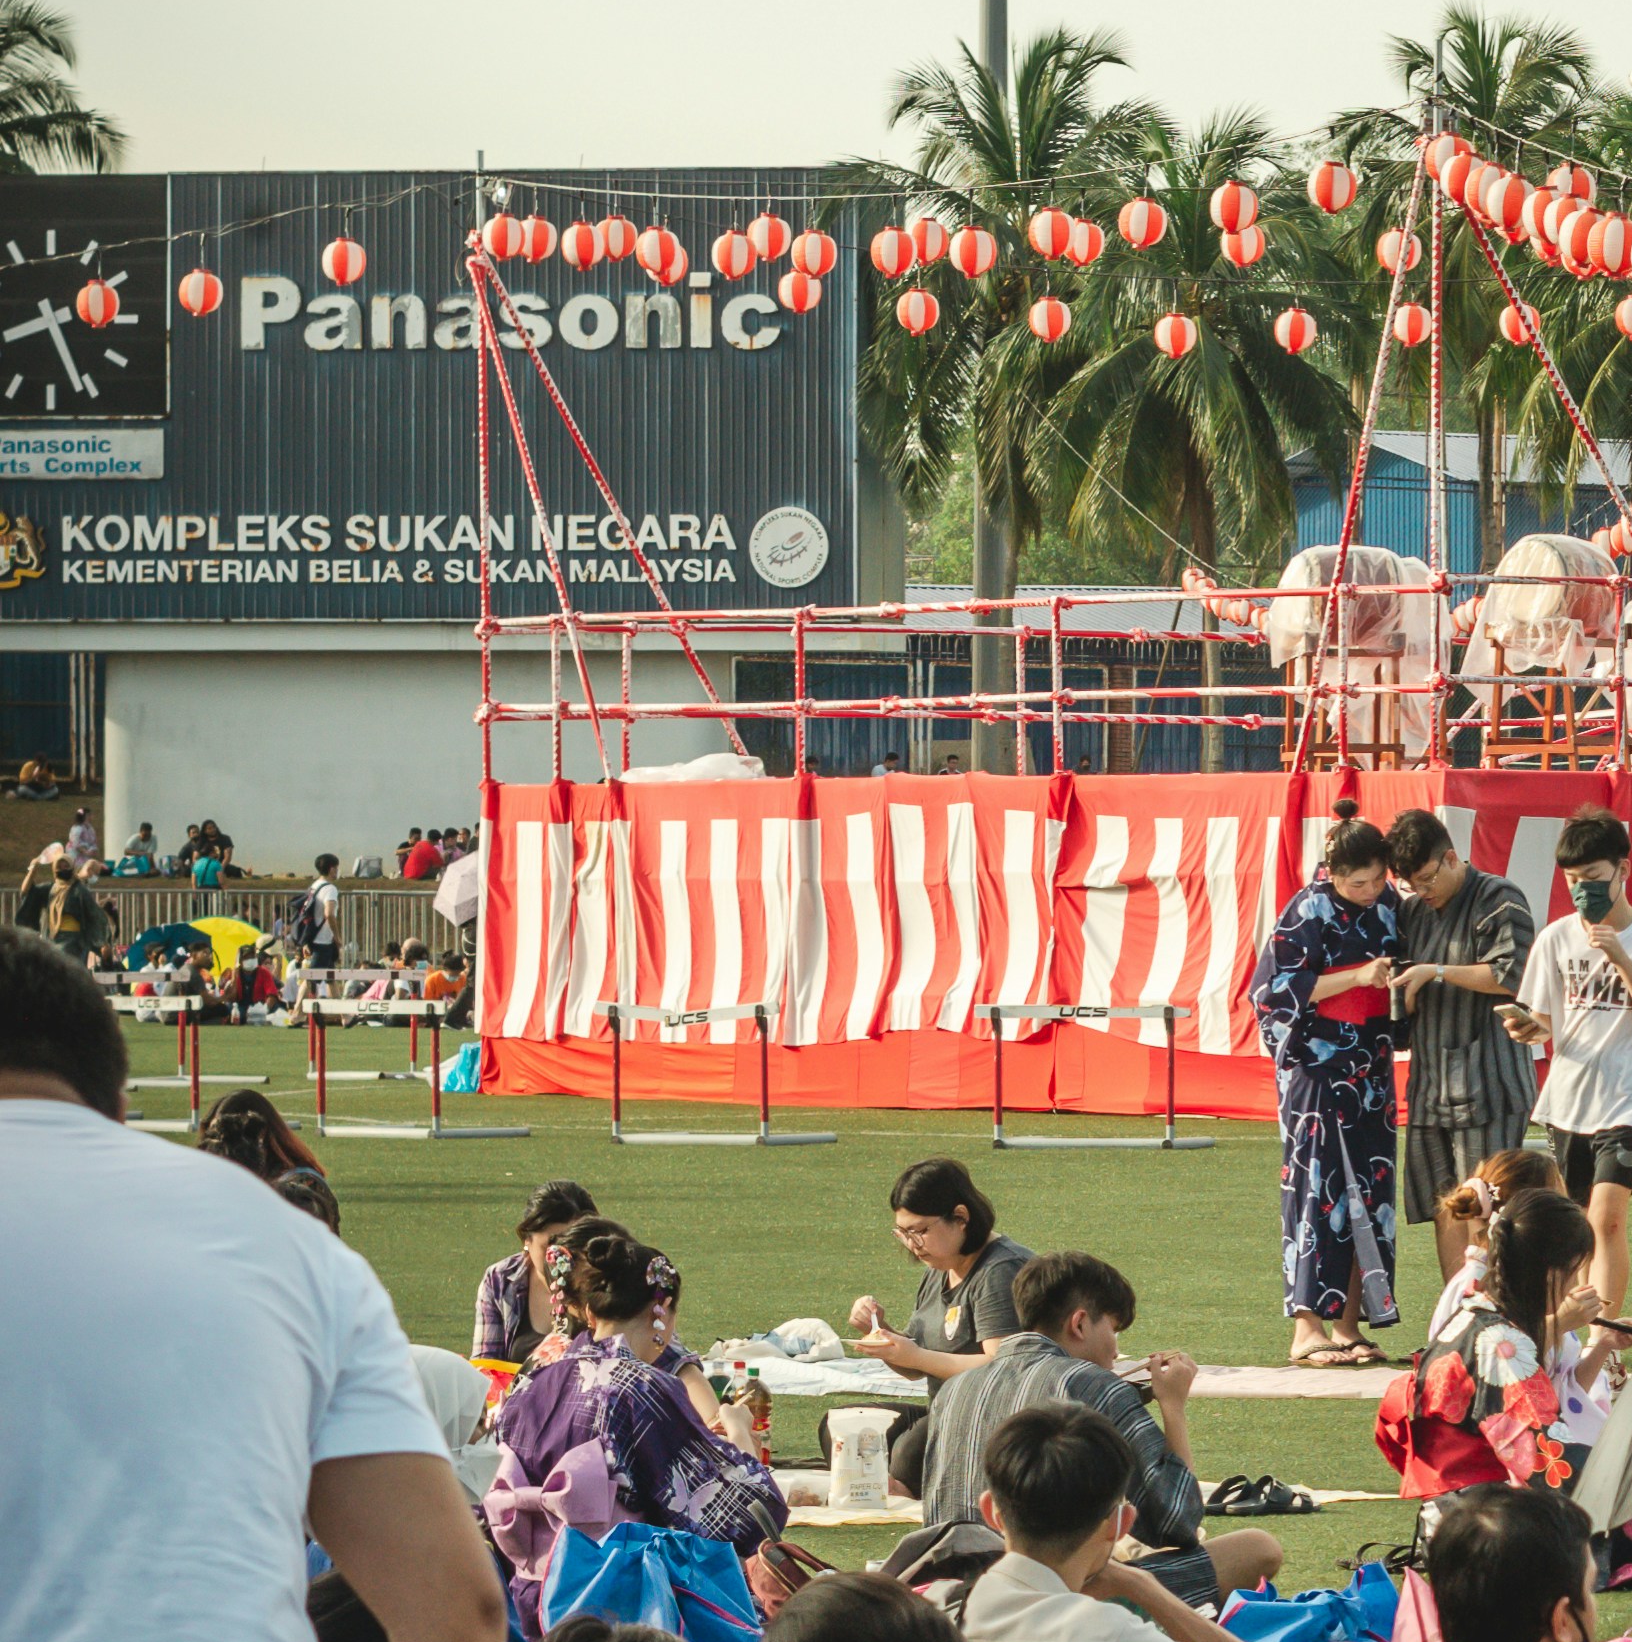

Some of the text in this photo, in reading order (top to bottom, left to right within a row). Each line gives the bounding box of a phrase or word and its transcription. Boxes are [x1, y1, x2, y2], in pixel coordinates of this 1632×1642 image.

[241, 271, 781, 351] Panasonic
[0, 435, 112, 454] anasonic
[0, 457, 142, 476] rts Complex
[61, 513, 738, 552] KOMPLEKS SUKAN NEGARA
[62, 559, 737, 584] KEMENTERIAN BELIA & SUKAN MALAYSIA
[1568, 959, 1589, 973] AM
[137, 998, 160, 1009] UCS
[357, 1001, 390, 1012] UCS
[1059, 1006, 1109, 1018] UCS
[667, 1011, 709, 1027] UCS
